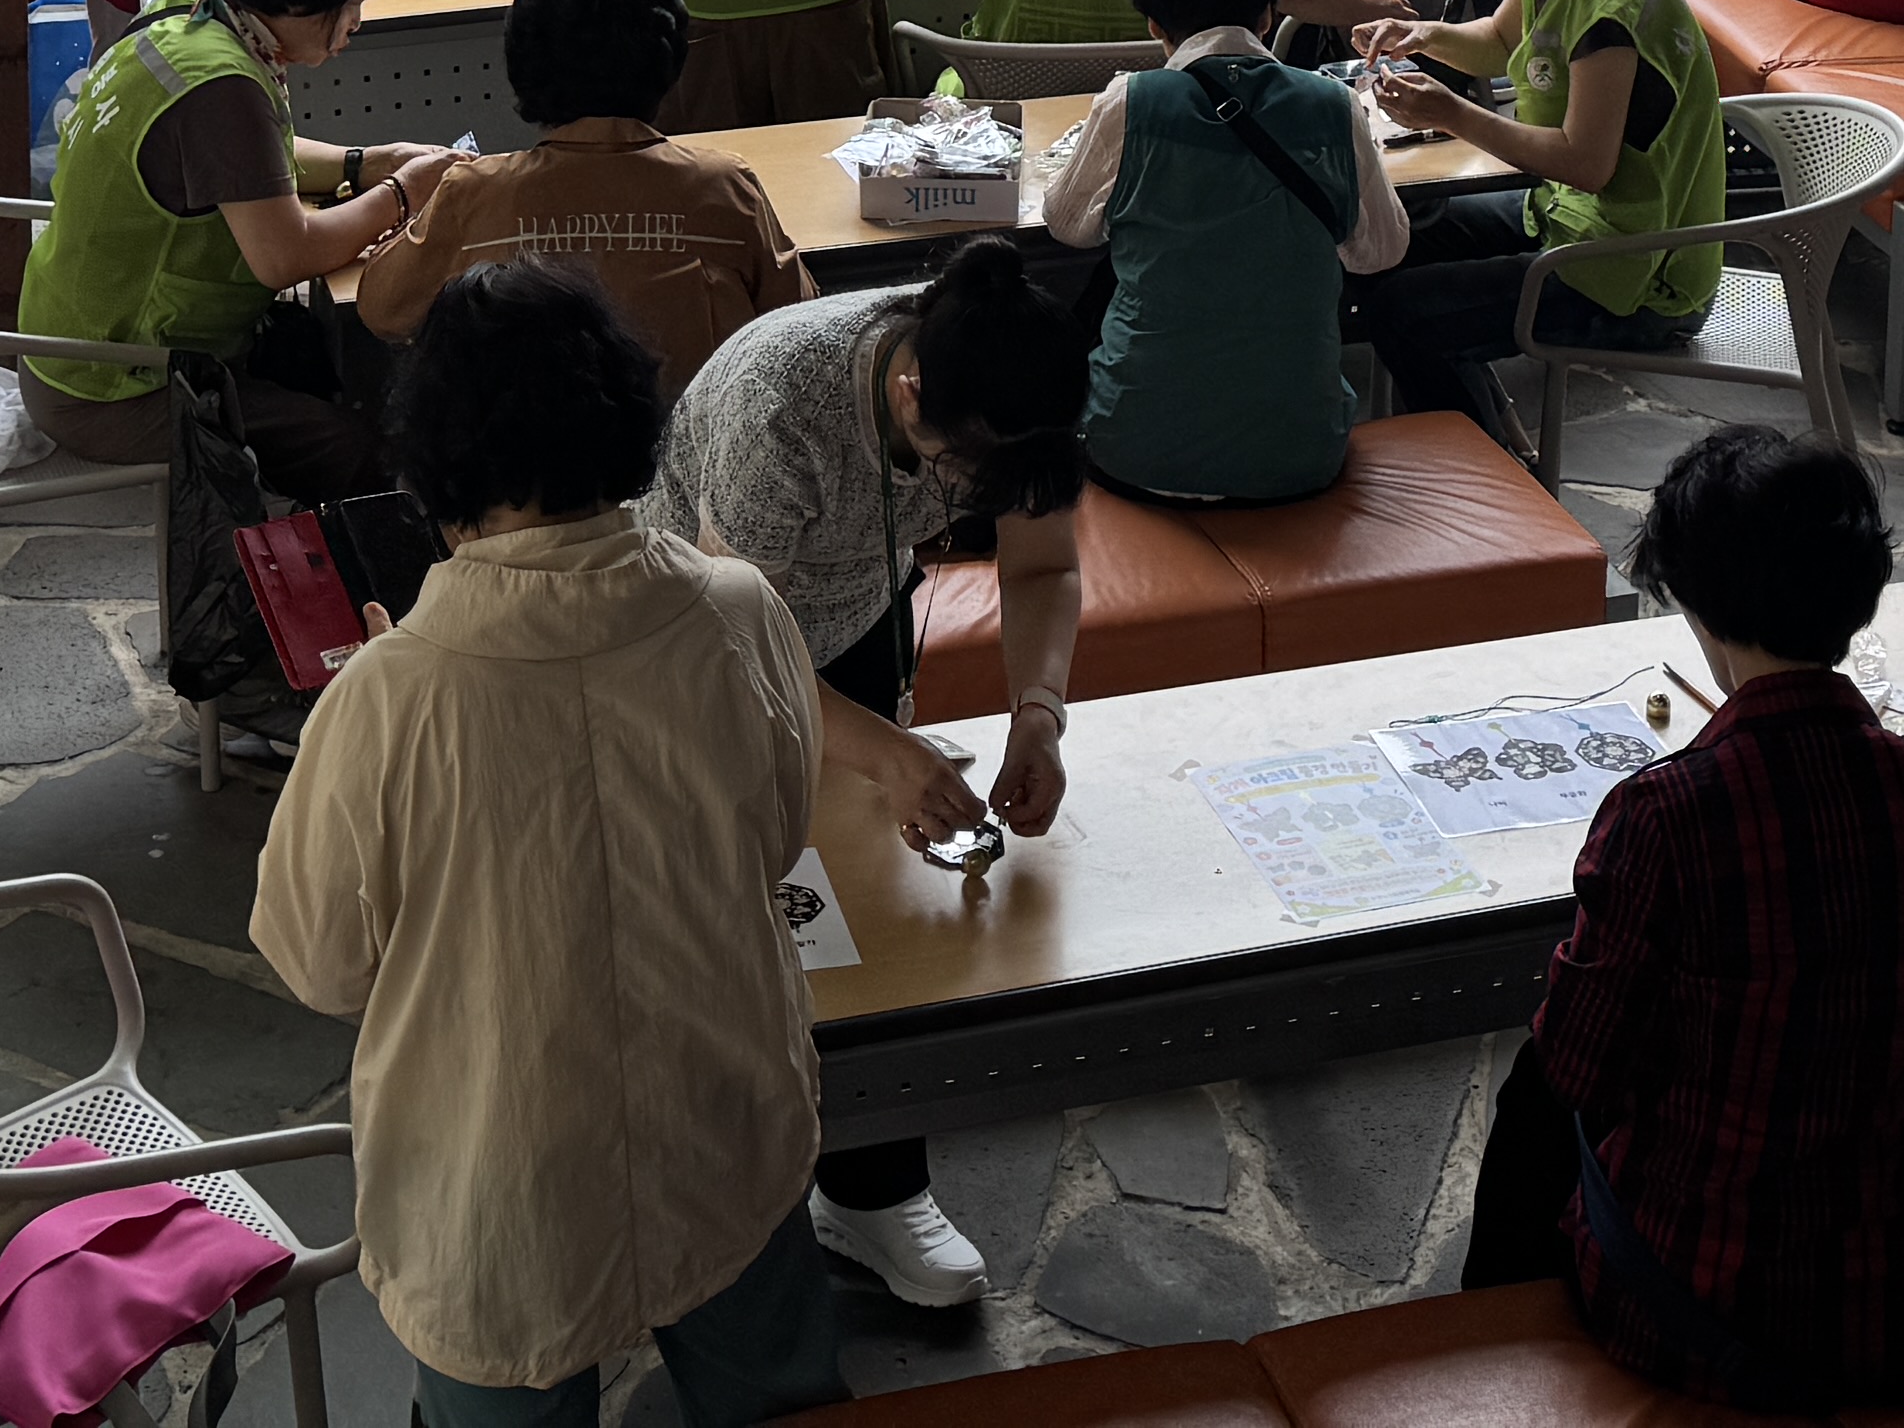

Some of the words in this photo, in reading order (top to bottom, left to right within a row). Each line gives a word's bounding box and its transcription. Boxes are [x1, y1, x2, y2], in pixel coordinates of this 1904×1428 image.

[903, 186, 976, 213] miilk
[517, 214, 619, 253] HAPPY
[626, 213, 686, 253] LIFE
